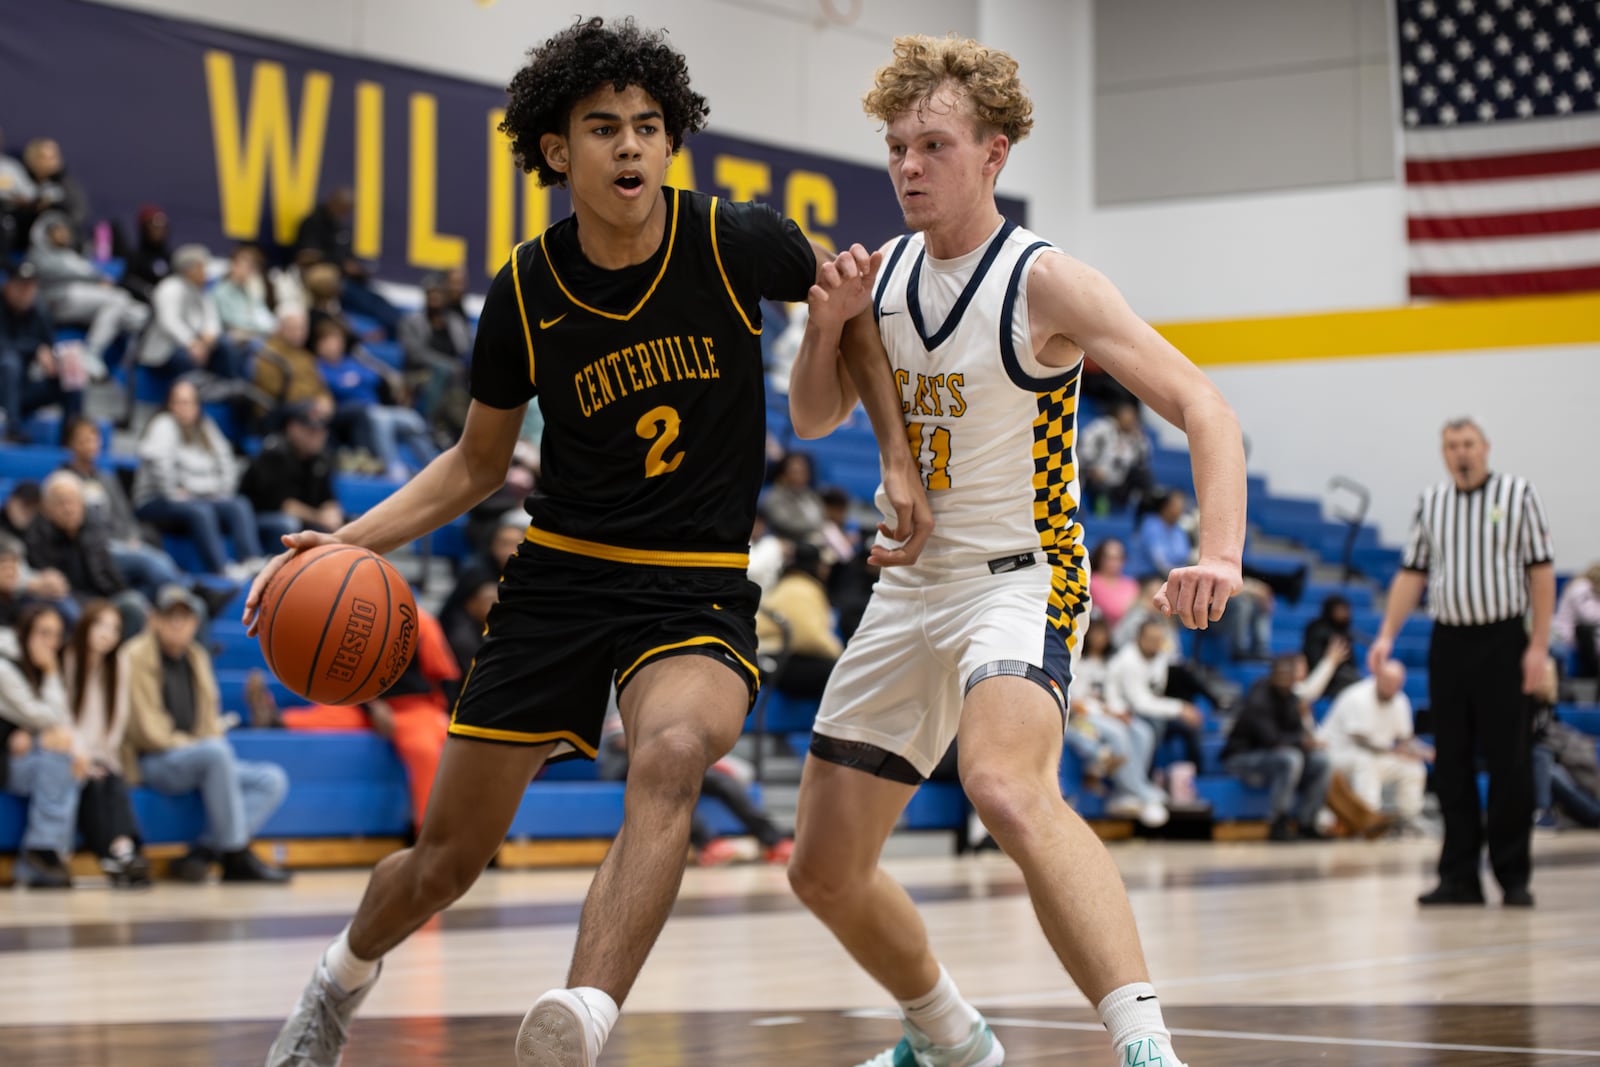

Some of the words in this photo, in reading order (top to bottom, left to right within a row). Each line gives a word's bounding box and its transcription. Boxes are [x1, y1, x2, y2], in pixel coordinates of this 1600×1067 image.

[204, 50, 837, 281] WILDTS
[574, 335, 720, 417] CENTERVILLE
[894, 368, 967, 417] CATS
[635, 405, 686, 479] 2
[379, 603, 415, 692] Rawling
